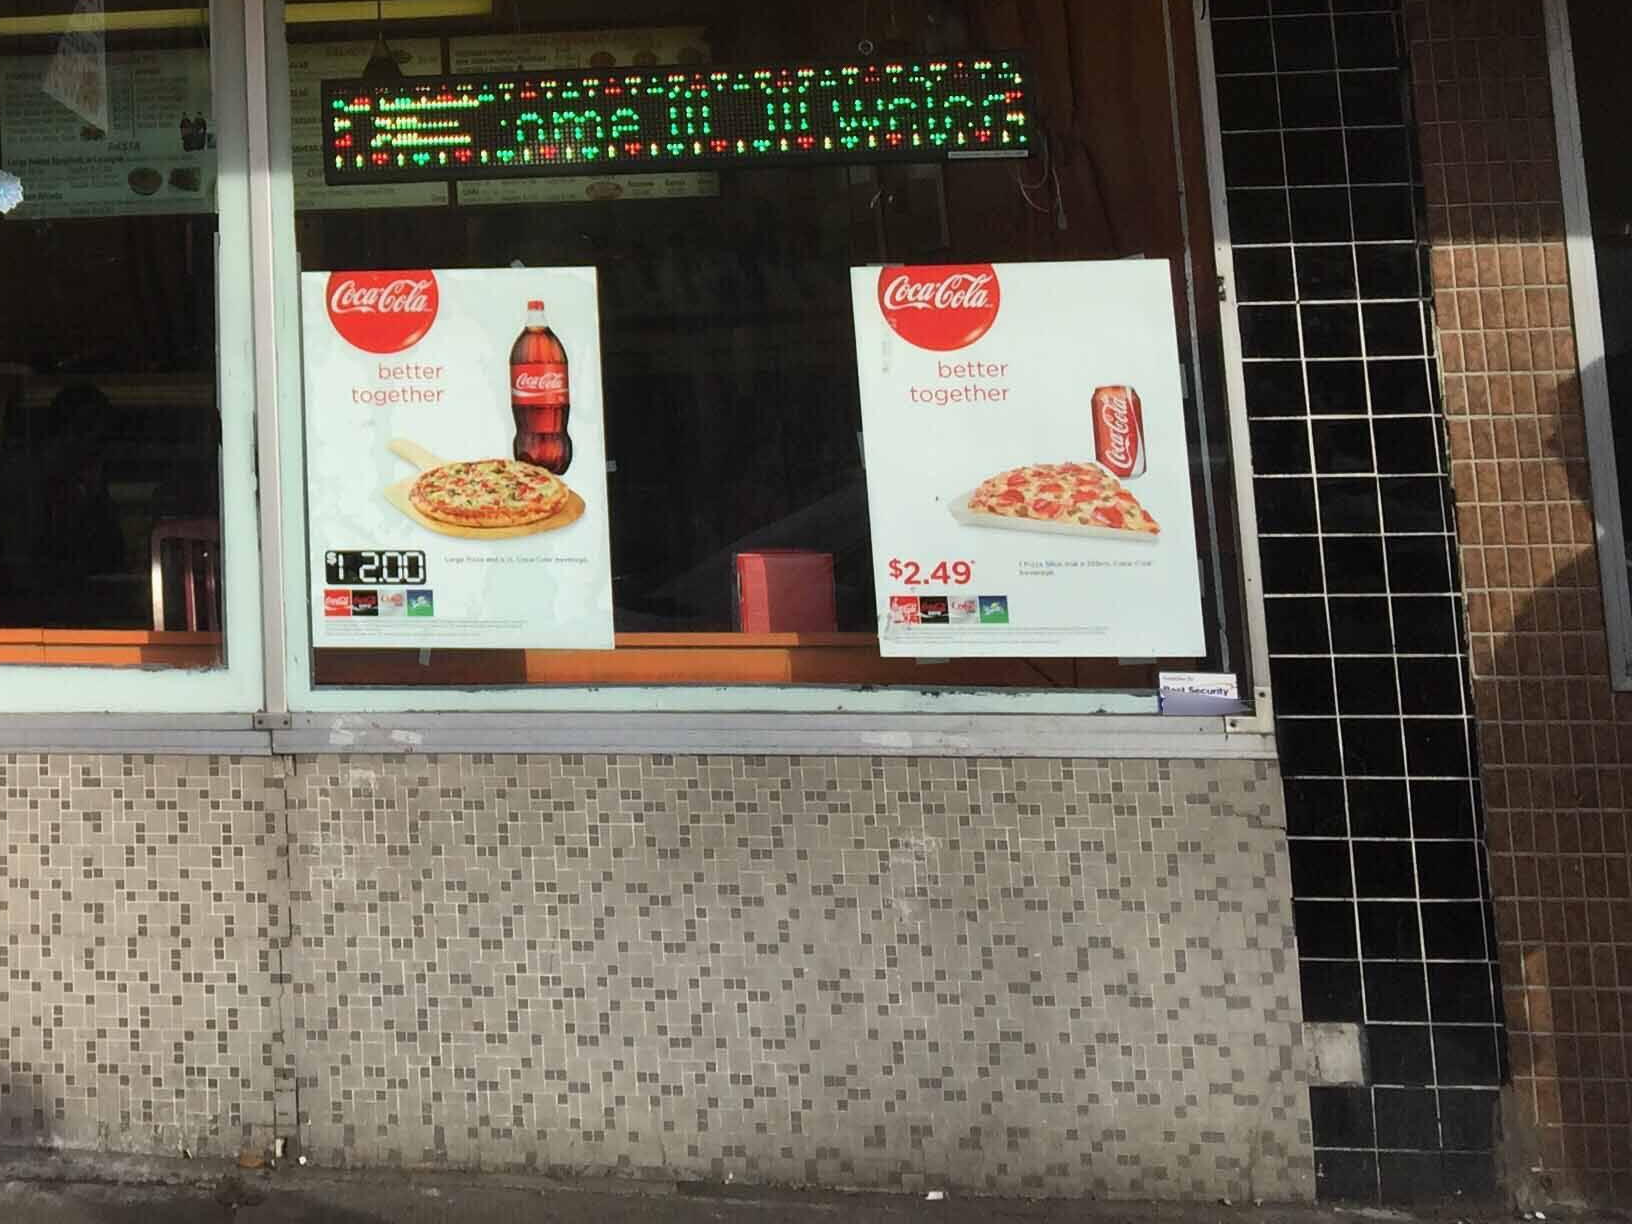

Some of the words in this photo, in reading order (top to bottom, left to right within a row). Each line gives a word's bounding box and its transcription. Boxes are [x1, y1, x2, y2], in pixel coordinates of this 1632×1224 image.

[331, 279, 432, 314] Coca-Cola
[884, 273, 993, 310] Coca-Cola
[378, 362, 443, 380] better
[938, 360, 1008, 379] better
[351, 385, 443, 407] together
[910, 385, 1008, 407] together
[1102, 395, 1133, 469] Coca-Cola
[1188, 686, 1229, 697] Security
